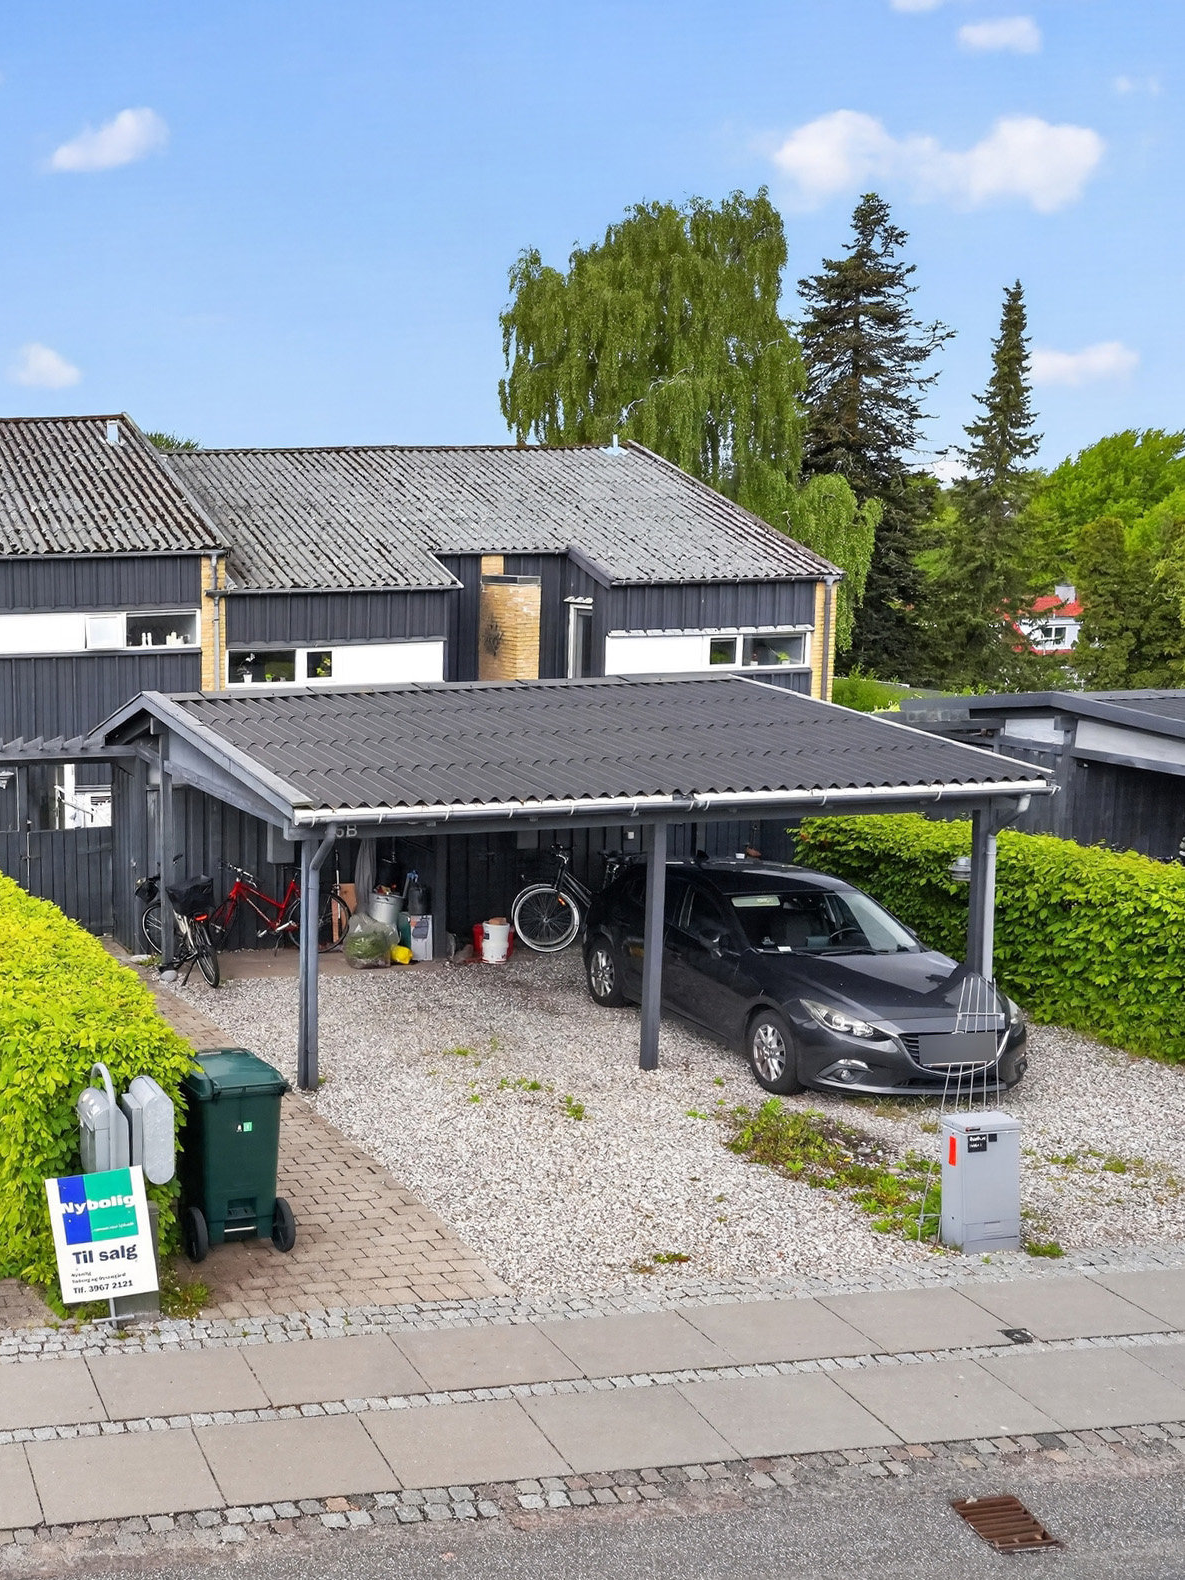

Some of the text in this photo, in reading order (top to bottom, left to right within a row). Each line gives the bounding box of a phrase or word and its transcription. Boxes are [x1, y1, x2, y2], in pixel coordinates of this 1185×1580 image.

[60, 1195, 136, 1215] Nybolig
[72, 1244, 138, 1264] Til salg
[88, 1283, 110, 1293] 3967
[112, 1280, 134, 1289] 2121
